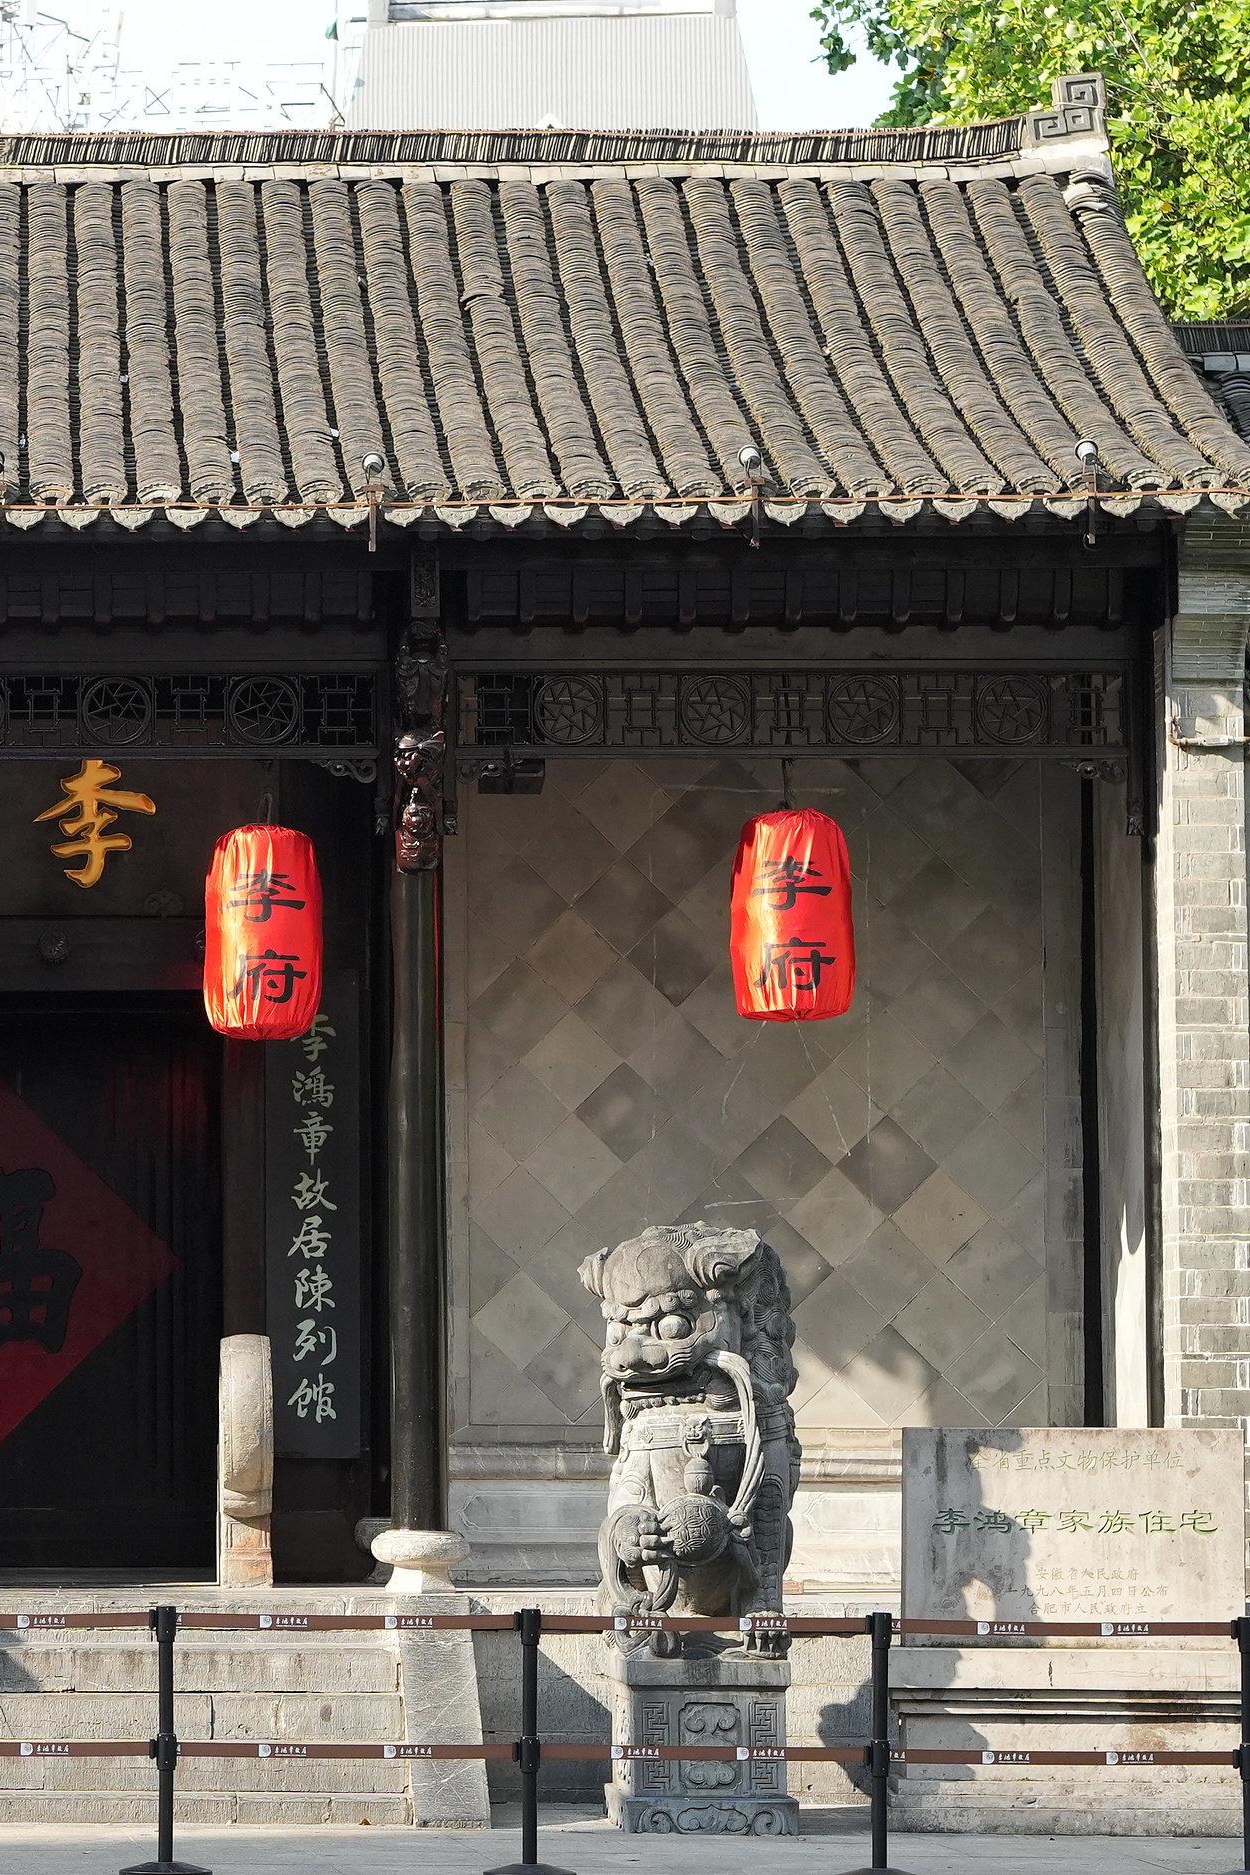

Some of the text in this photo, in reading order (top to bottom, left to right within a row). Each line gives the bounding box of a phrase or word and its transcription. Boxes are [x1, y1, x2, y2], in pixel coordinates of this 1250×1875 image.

[750, 854, 835, 991] 李府
[225, 869, 309, 1004] 李府
[971, 1449, 1184, 1471] 全省重点文物保护单位
[931, 1507, 1219, 1535] 李鸿章家族住宅
[1036, 1566, 1140, 1581] 安徽省人民政府
[1006, 1584, 1169, 1599] 一九九八年五月四日公布
[1027, 1600, 1148, 1616] 合肥市人民政府立
